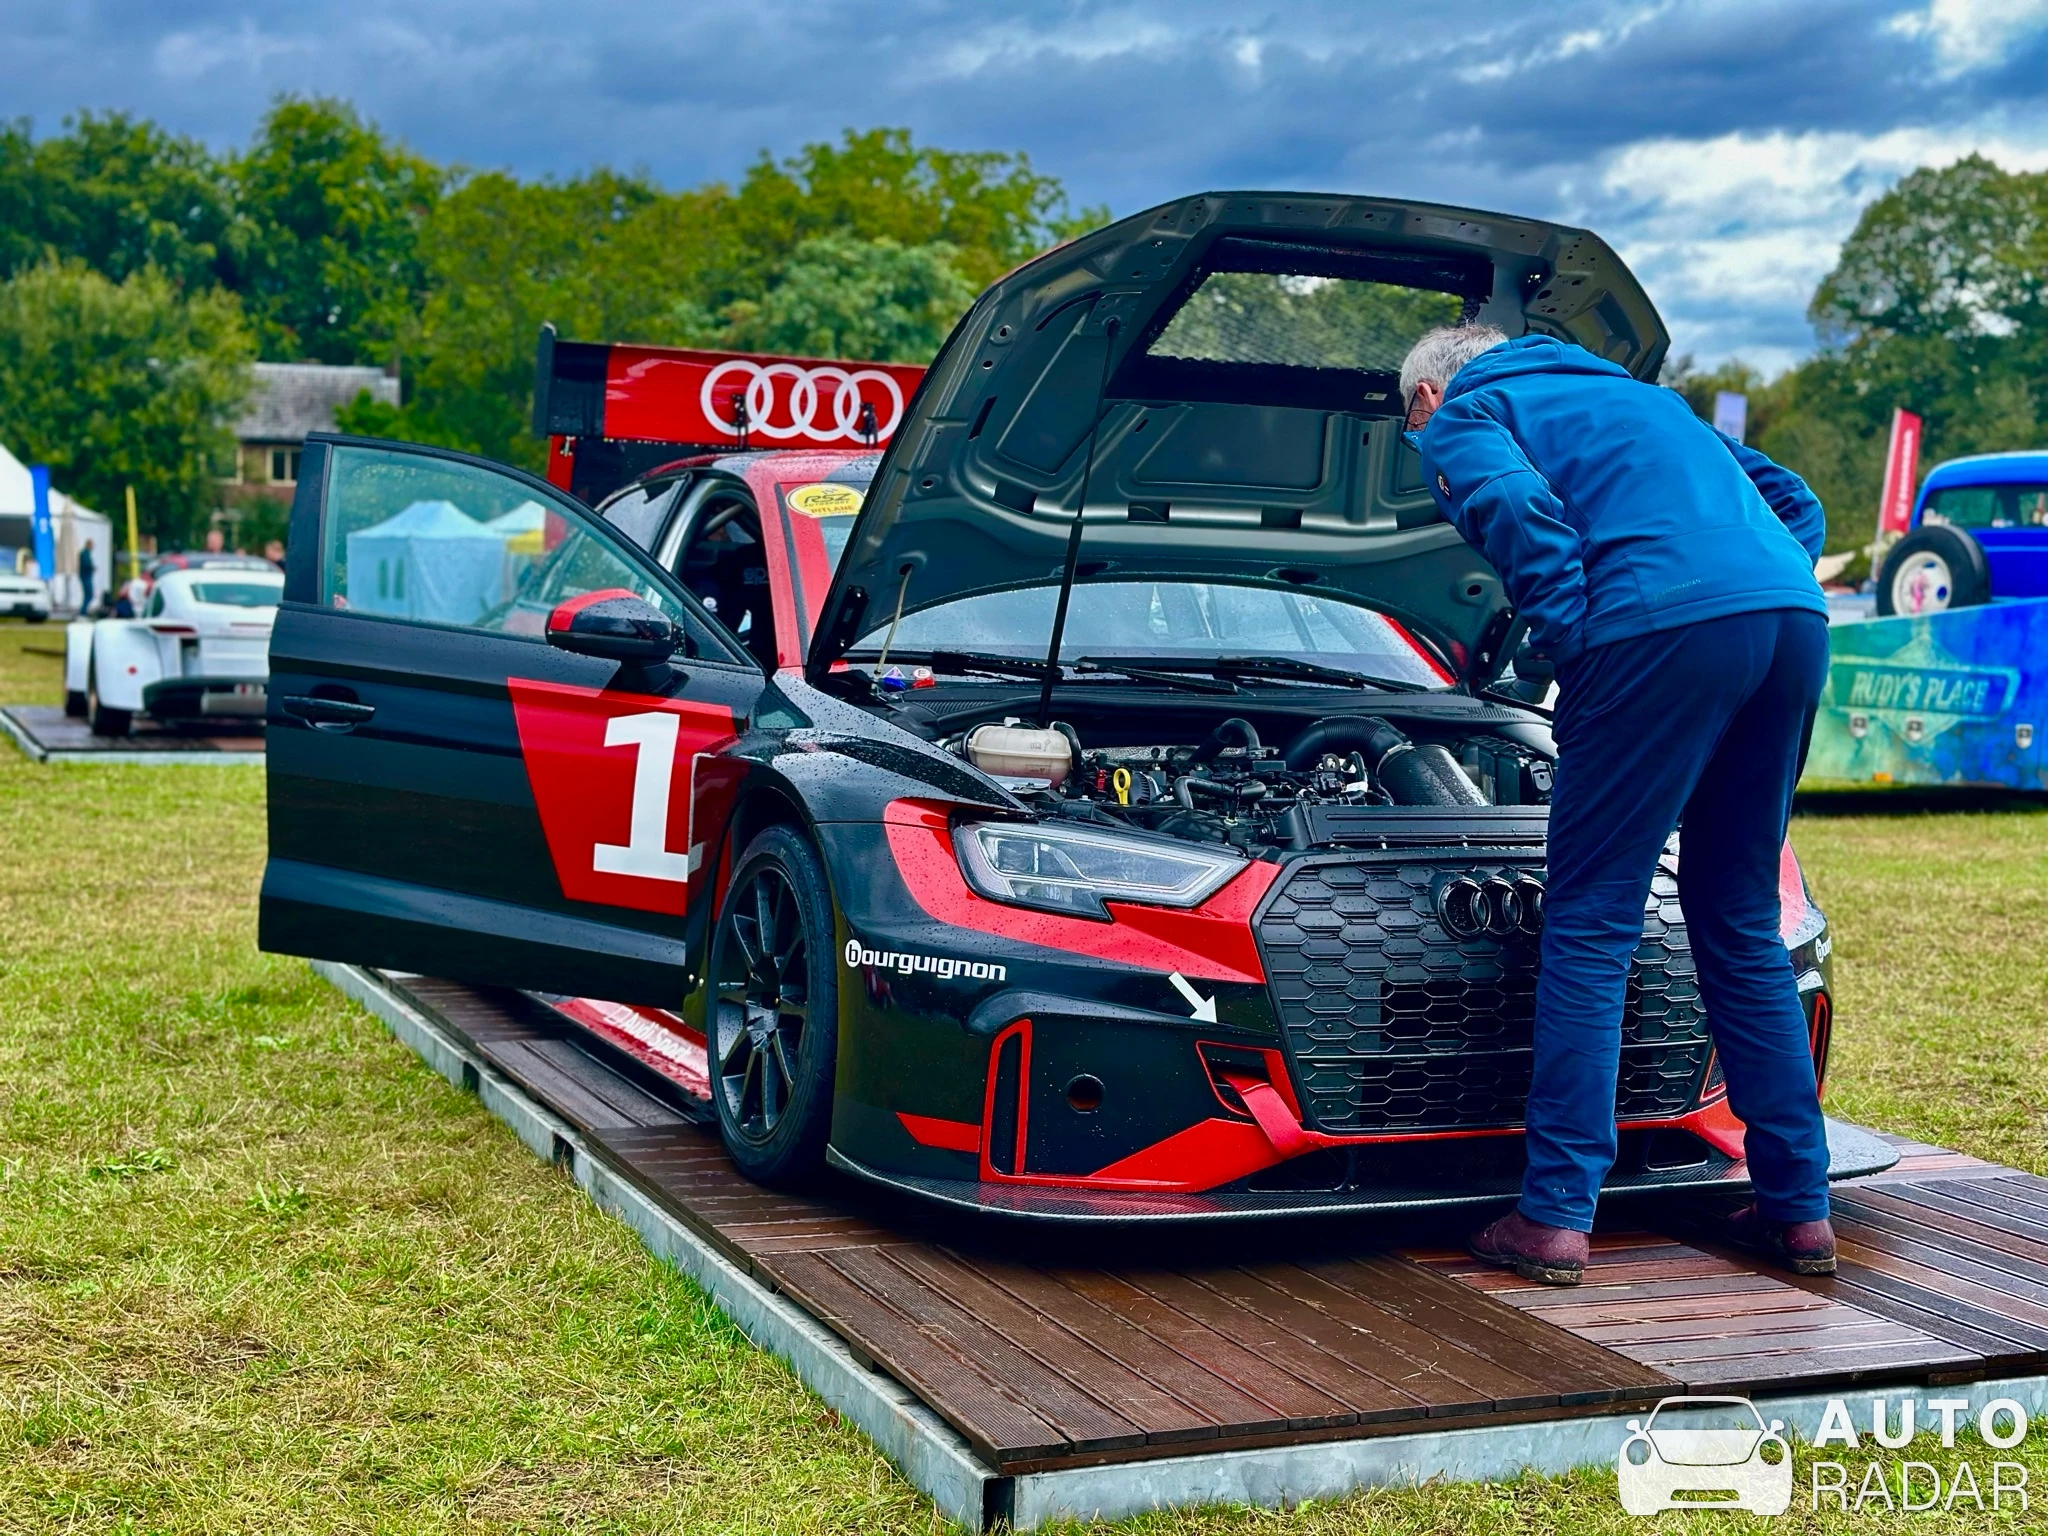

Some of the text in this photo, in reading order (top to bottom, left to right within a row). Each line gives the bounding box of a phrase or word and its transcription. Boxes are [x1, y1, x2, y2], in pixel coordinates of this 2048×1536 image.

[811, 505, 855, 513] PITLANE
[1848, 671, 1991, 713] RUDY'S PLACE
[593, 711, 704, 884] 1
[845, 939, 1007, 981] bourguignon
[619, 1012, 693, 1064] Audi Sport
